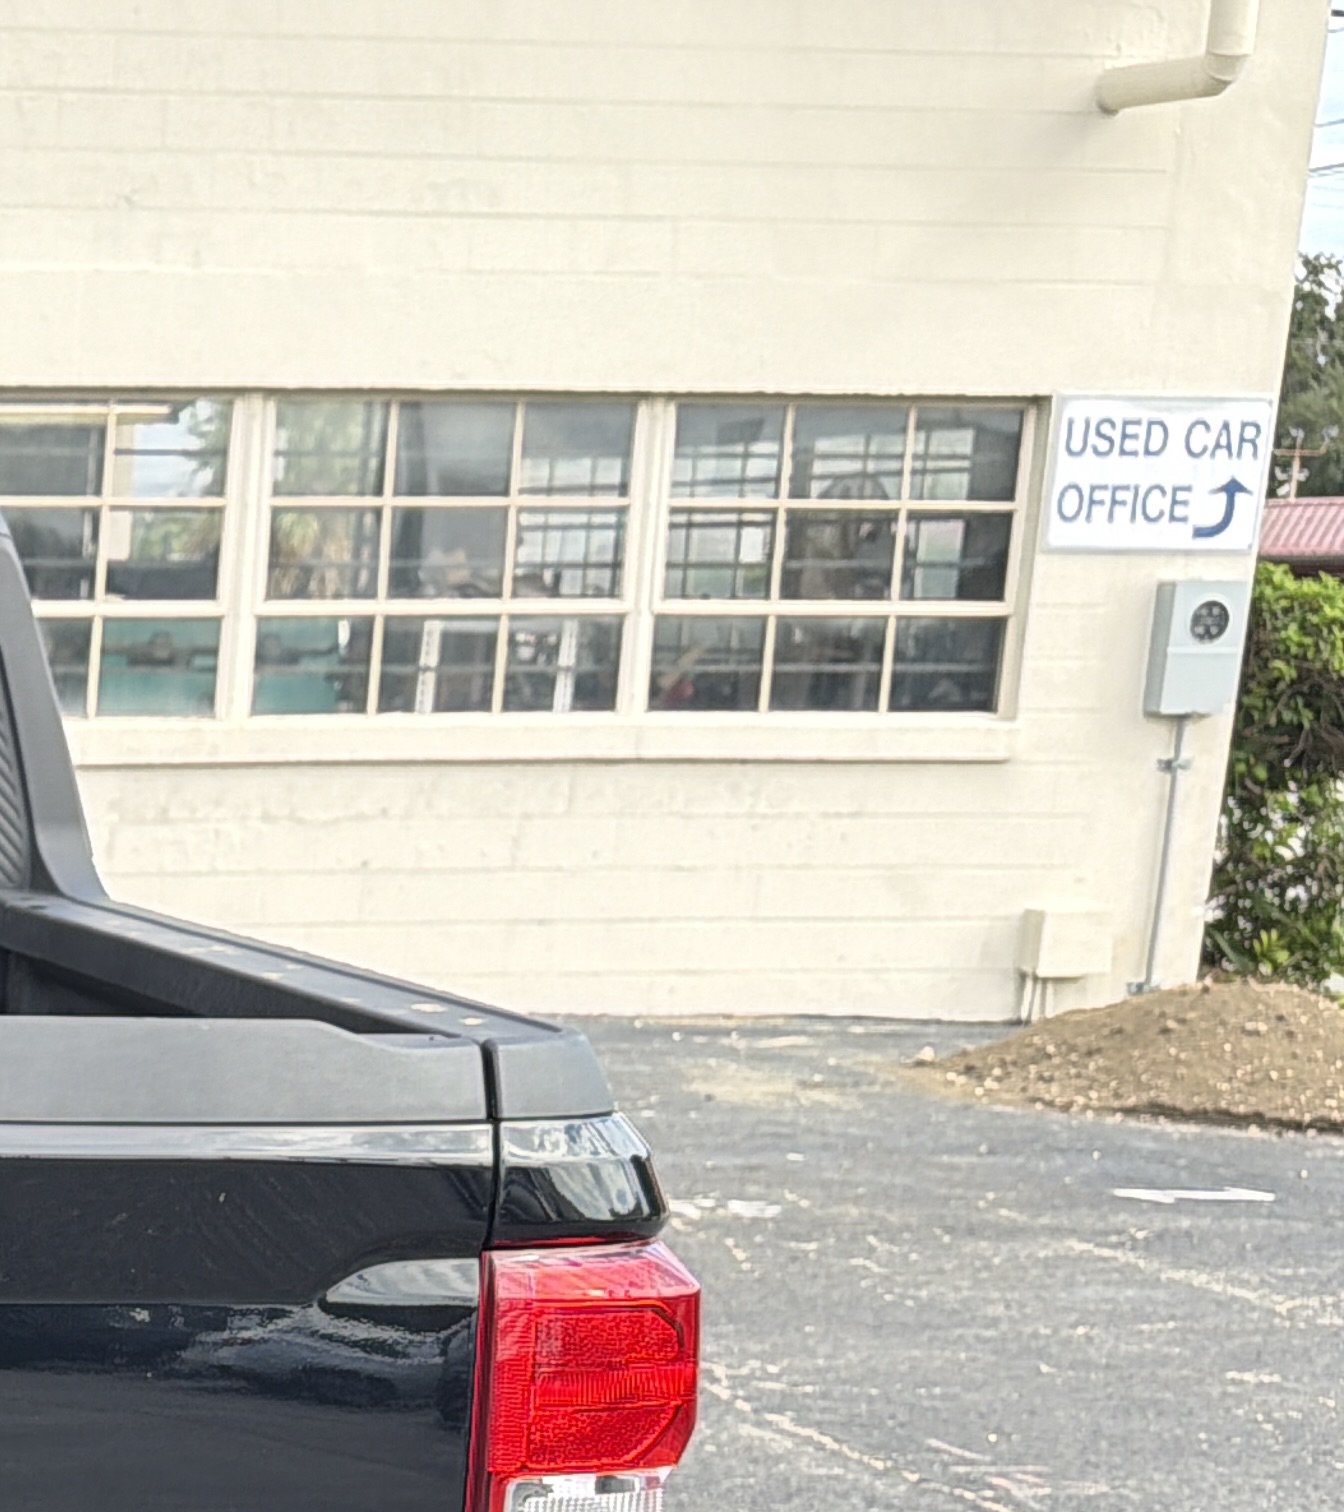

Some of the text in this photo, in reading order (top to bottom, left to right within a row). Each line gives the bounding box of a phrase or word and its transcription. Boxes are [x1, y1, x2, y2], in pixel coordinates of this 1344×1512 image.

[1065, 416, 1261, 460] USED CAR
[1056, 482, 1193, 524] OFFICE
